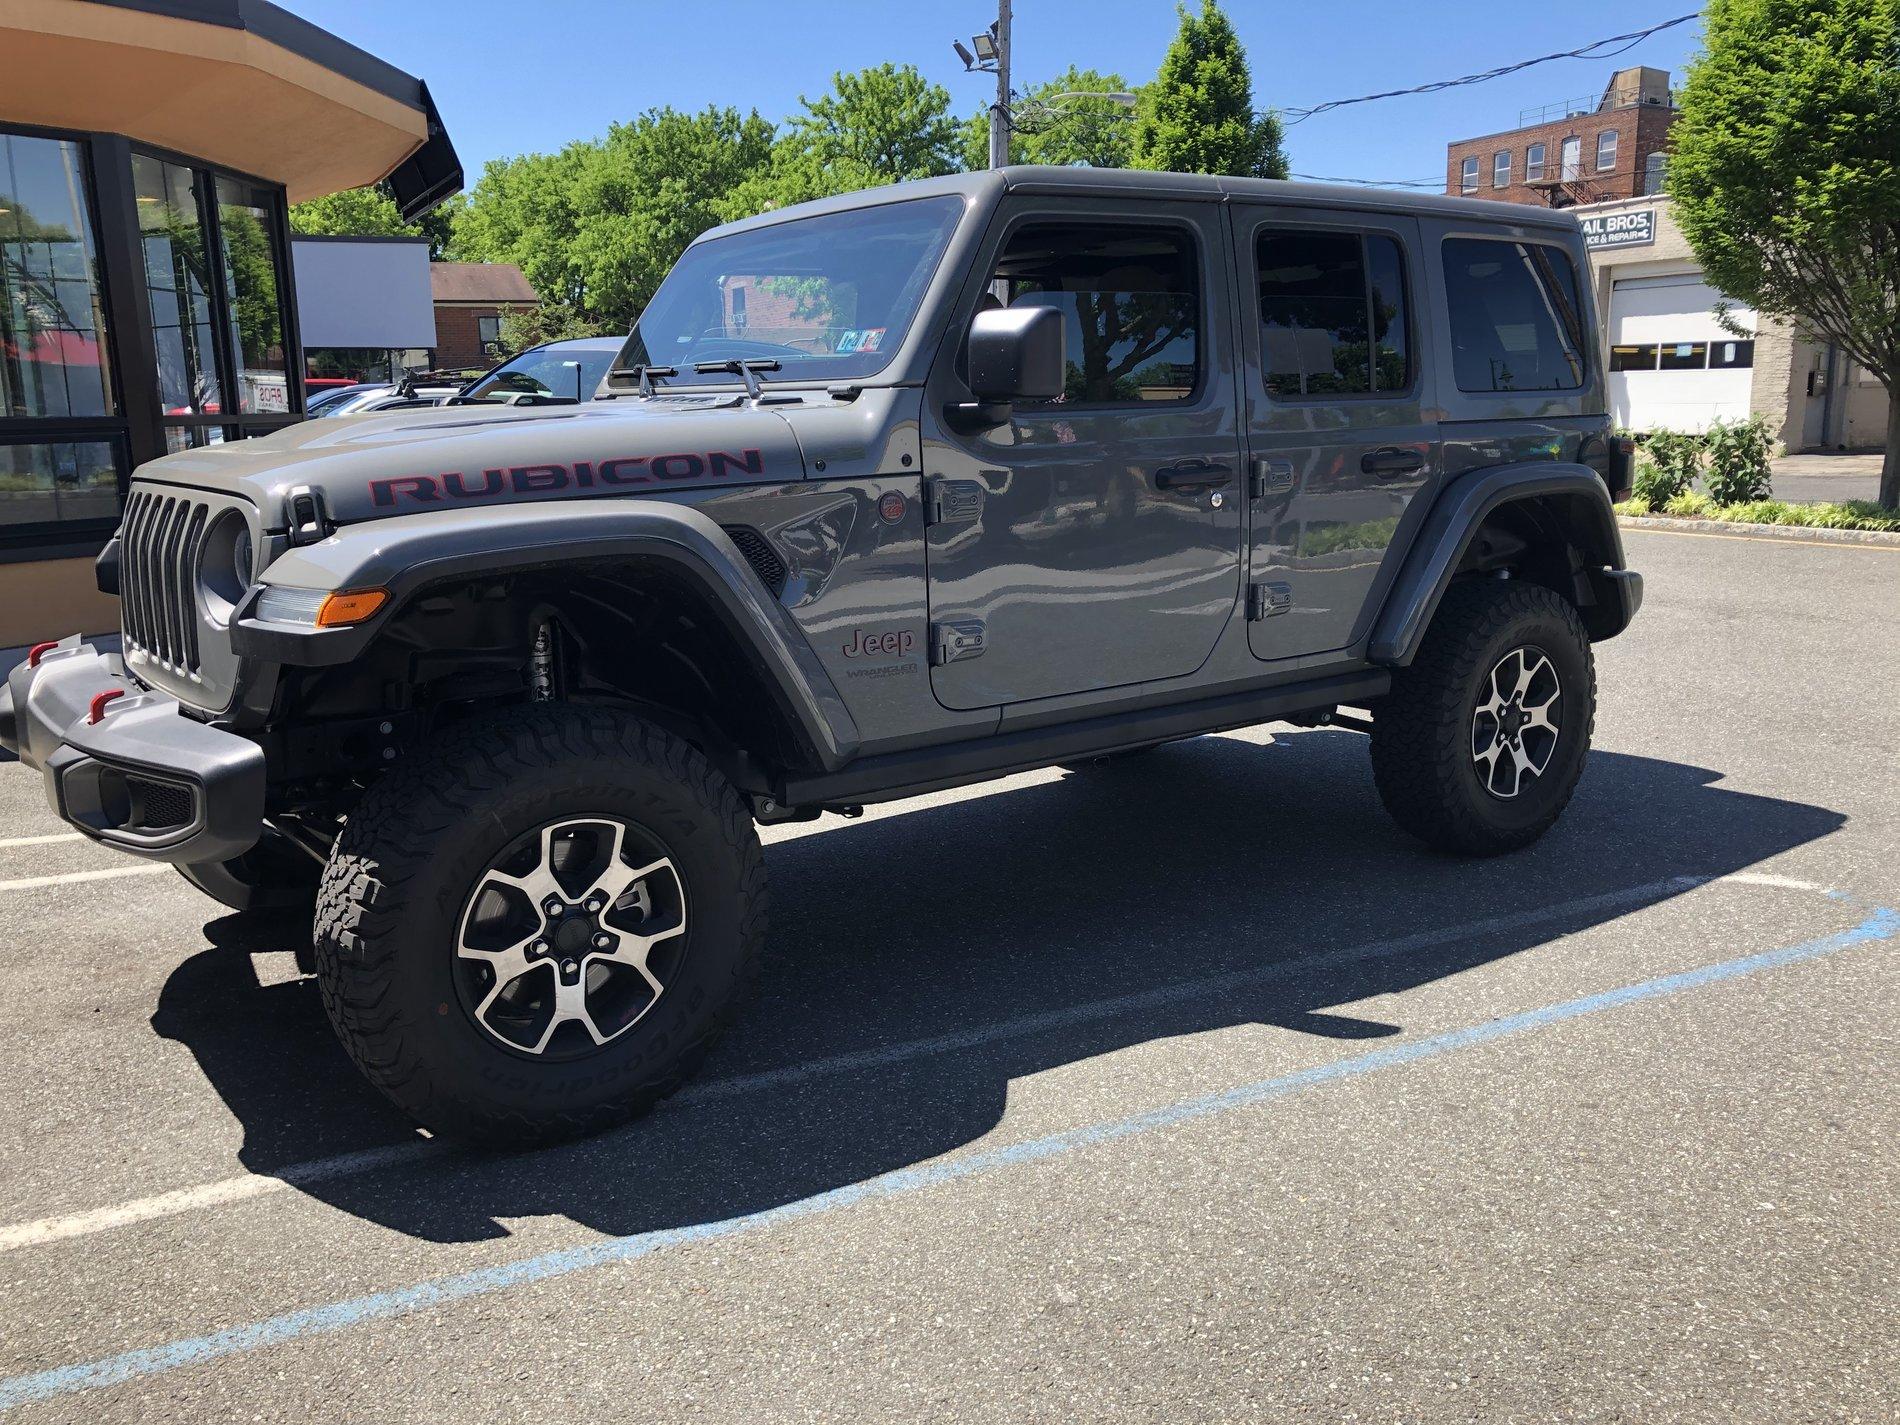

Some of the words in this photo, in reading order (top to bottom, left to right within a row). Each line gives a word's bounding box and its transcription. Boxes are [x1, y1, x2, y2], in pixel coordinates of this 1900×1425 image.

[1582, 220, 1604, 235] AIL
[1606, 213, 1650, 232] BROS.
[1586, 235, 1599, 245] ICE
[1600, 234, 1607, 243] &
[1608, 231, 1638, 242] REPAIR
[368, 449, 764, 507] RUBICON
[842, 629, 915, 658] Jeep
[846, 663, 917, 678] WRANGLER
